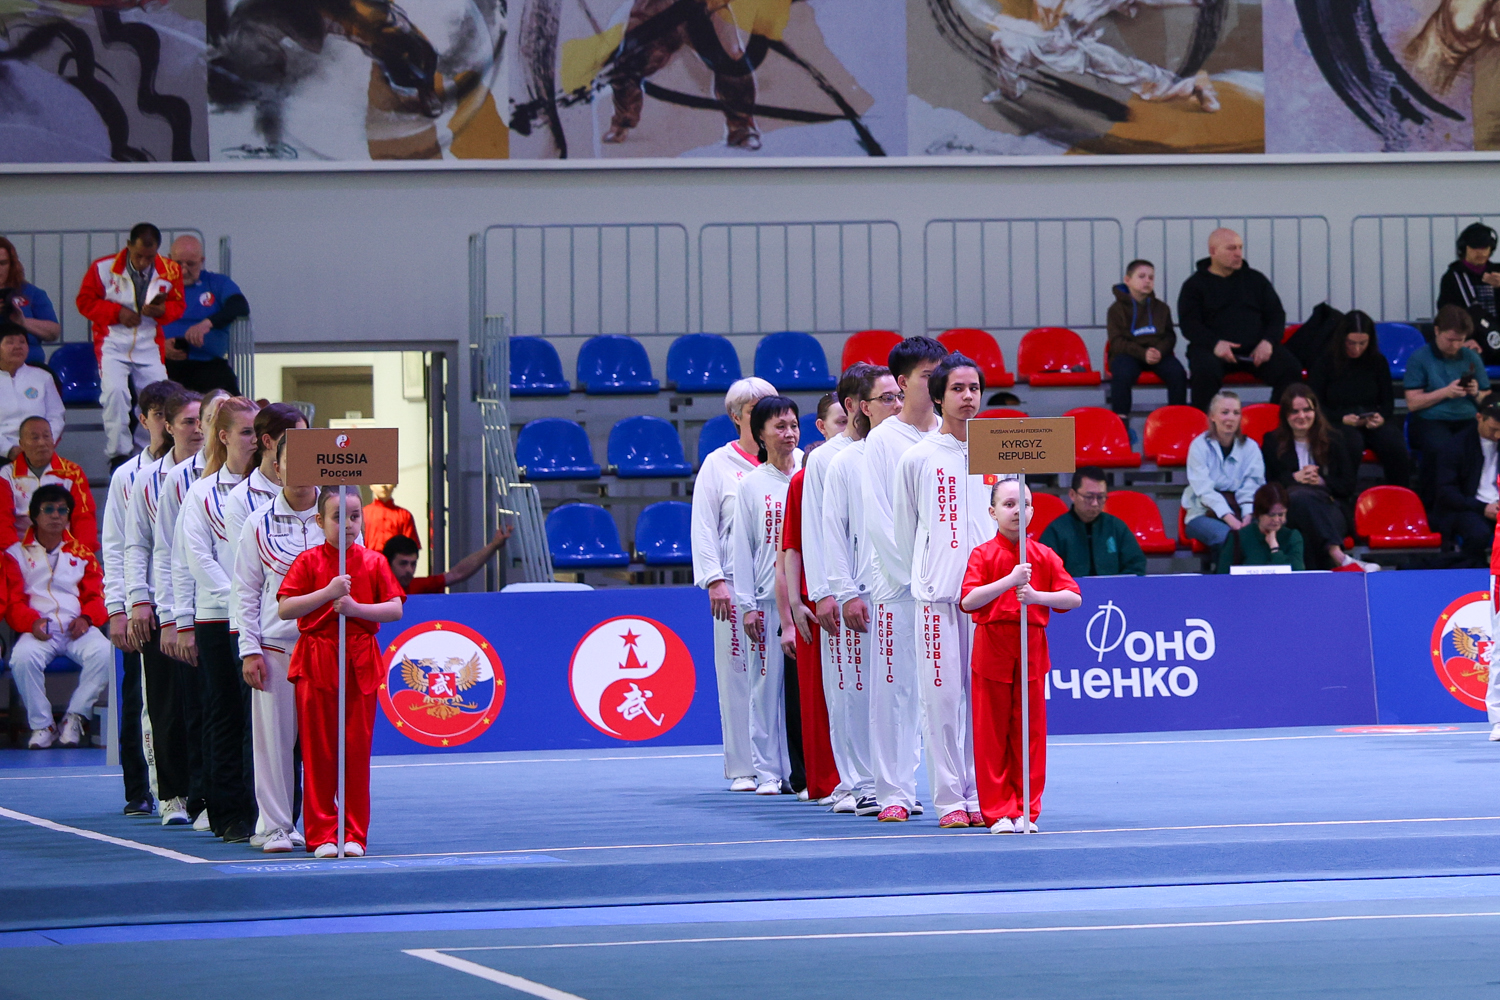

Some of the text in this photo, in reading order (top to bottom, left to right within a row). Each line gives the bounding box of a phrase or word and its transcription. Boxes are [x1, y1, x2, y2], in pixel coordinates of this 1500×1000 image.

[316, 453, 368, 465] RUSSIA
[998, 451, 1046, 460] REPUBLIC
[1001, 439, 1042, 449] KYRGYZ
[320, 468, 362, 478] Россия
[936, 467, 946, 522] KYRGYZ
[764, 494, 772, 544] KYRGYZ
[948, 476, 958, 549] REPUBLIC
[845, 630, 853, 664] RGYZ
[886, 612, 894, 684] REPUBLIC
[923, 605, 931, 659] KYRGYZ
[932, 614, 942, 687] REPUBLIC
[1085, 600, 1216, 662] Фонд
[430, 673, 454, 696] 武
[854, 631, 863, 691] EPUBLIC
[616, 682, 665, 727] 武
